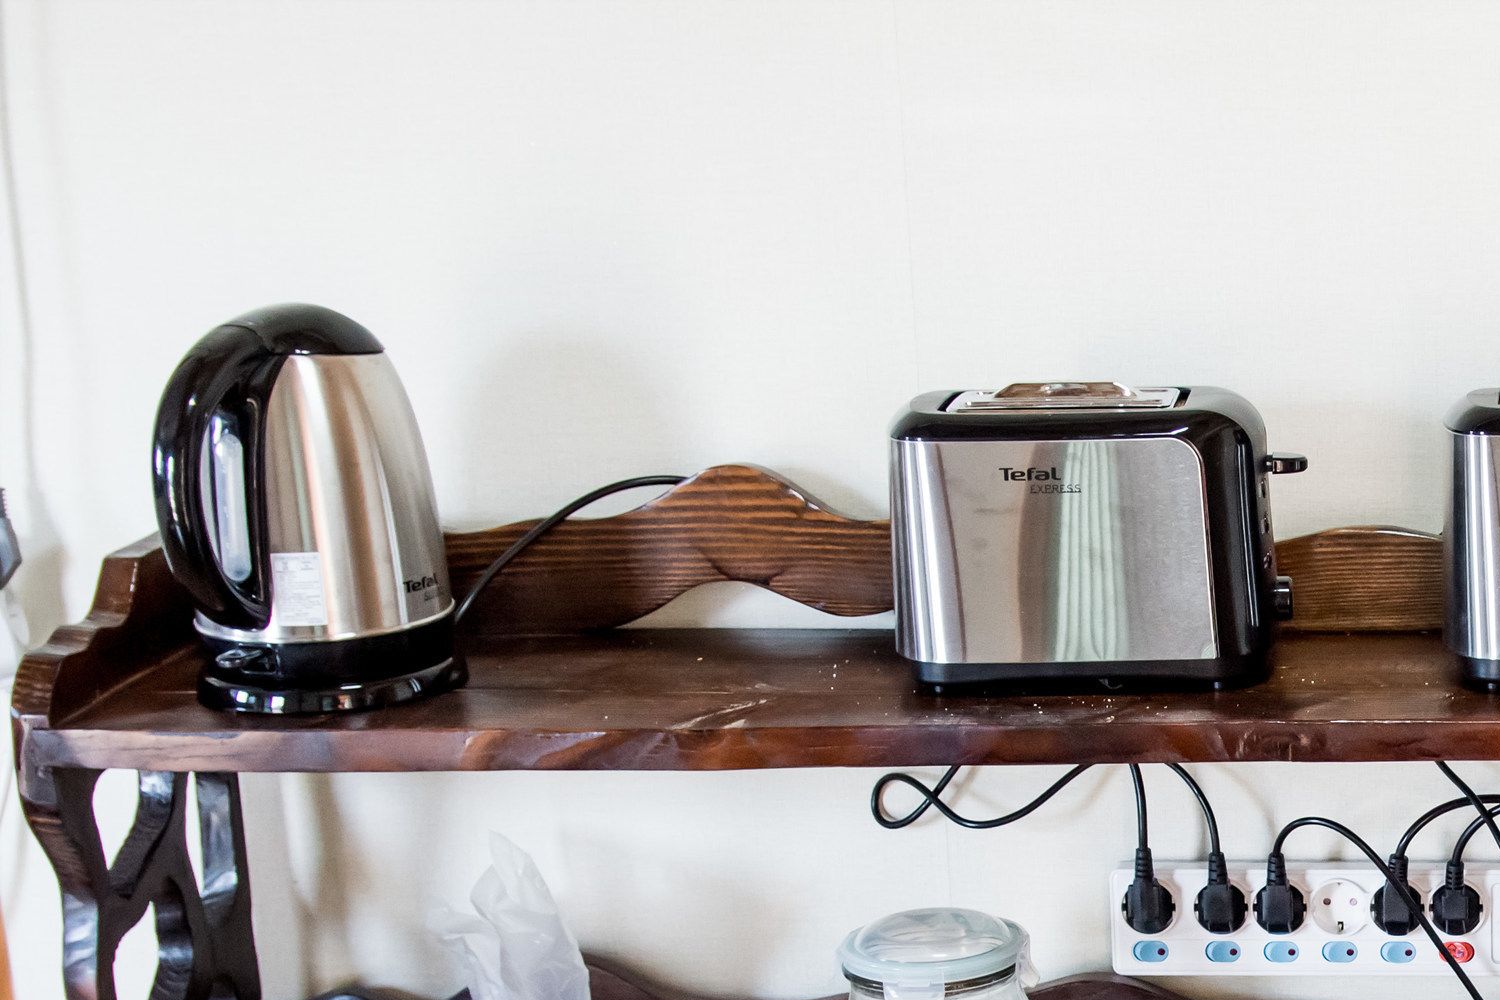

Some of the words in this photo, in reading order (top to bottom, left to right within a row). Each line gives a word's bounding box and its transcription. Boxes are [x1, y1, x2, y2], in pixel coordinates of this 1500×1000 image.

[998, 467, 1061, 481] Tefal
[1029, 484, 1082, 494] EXPRESS
[403, 573, 440, 593] Tefal
